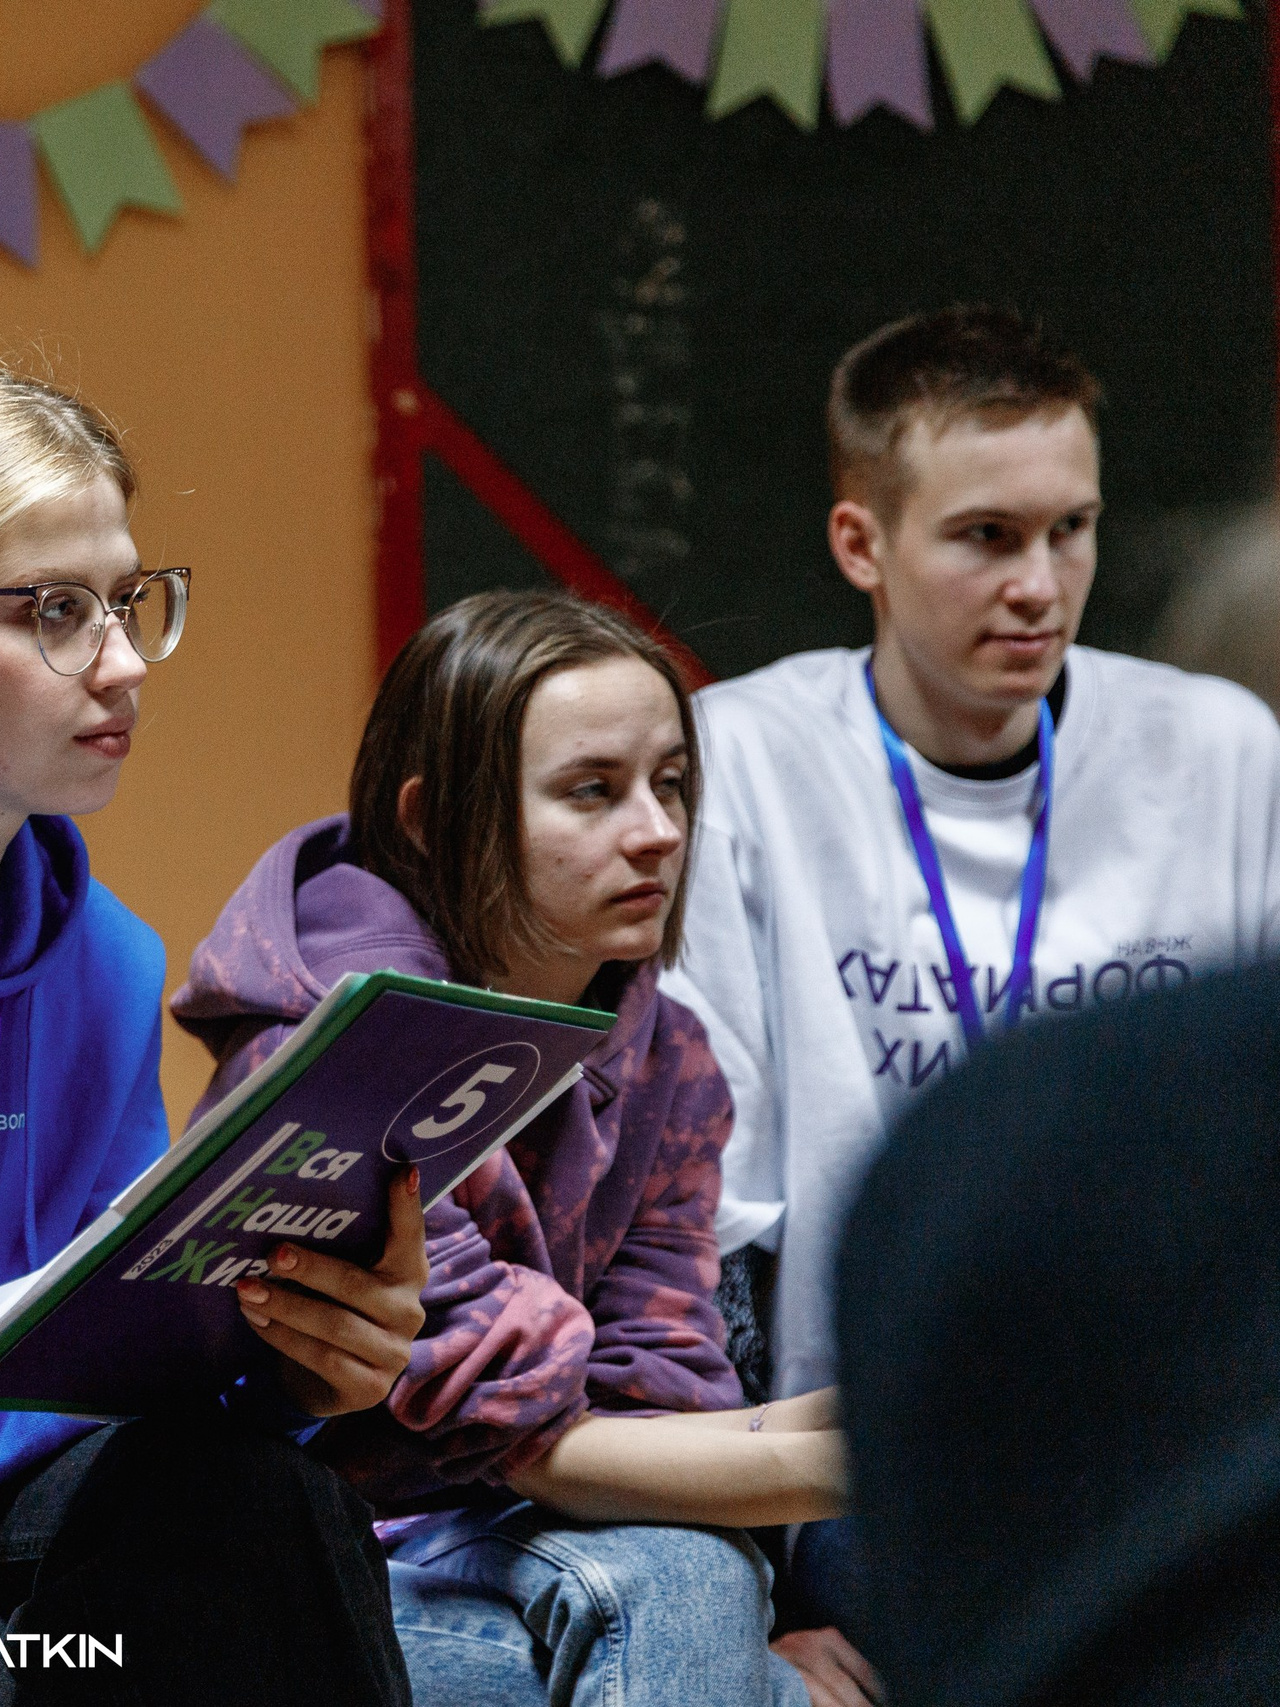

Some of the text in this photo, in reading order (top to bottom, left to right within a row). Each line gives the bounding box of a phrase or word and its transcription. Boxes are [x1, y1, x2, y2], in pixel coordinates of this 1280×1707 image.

[412, 1062, 518, 1140] 5
[263, 1131, 364, 1182] Вся
[205, 1186, 361, 1240] Наша
[131, 1238, 174, 1273] 2023
[143, 1239, 273, 1288] Жиз
